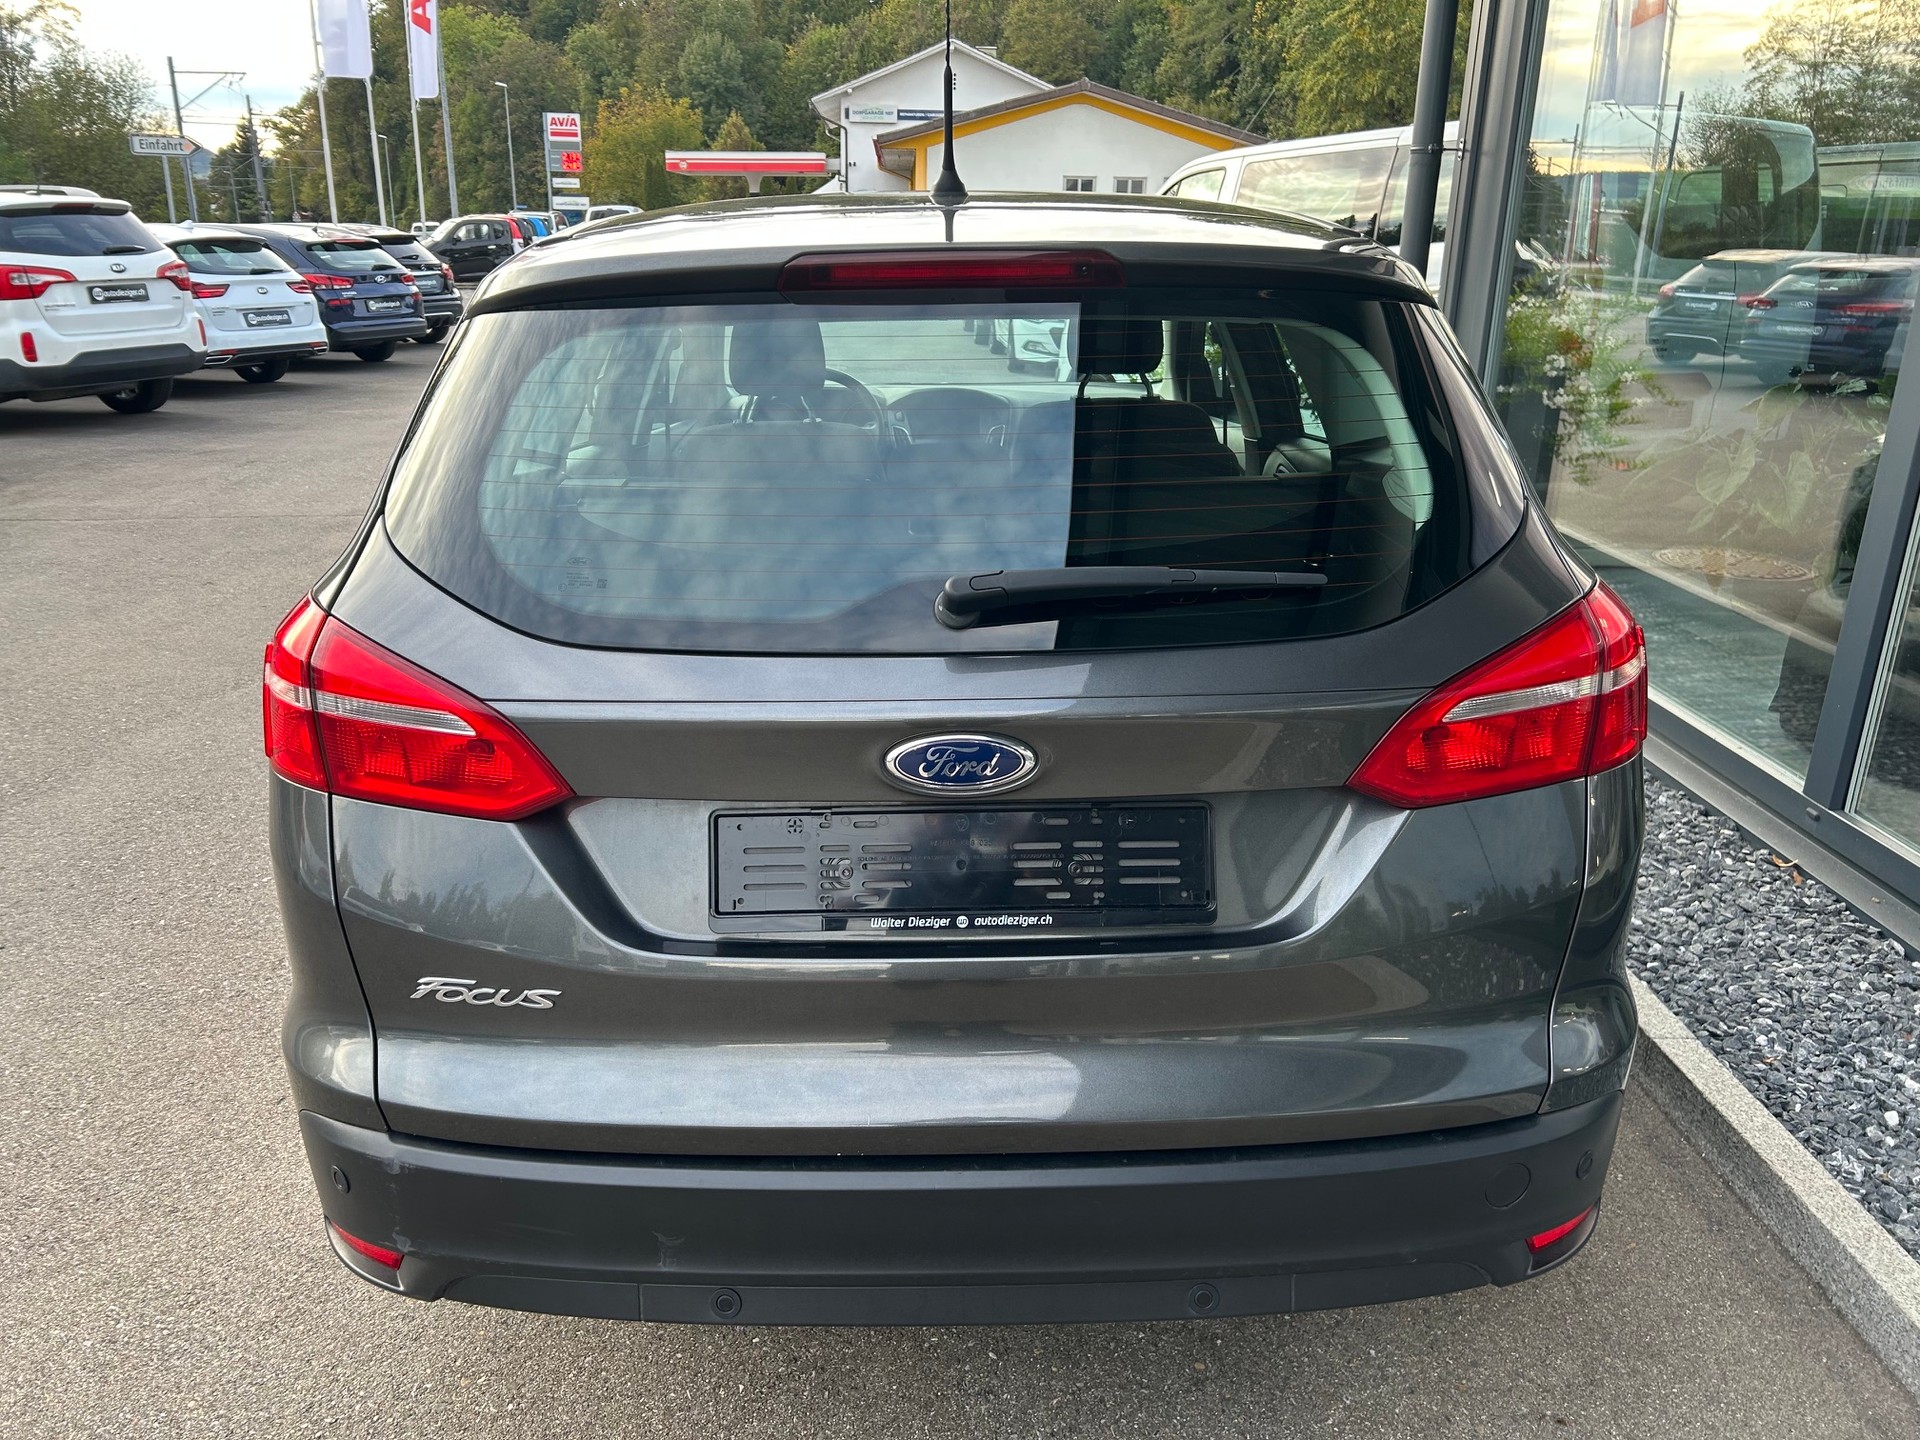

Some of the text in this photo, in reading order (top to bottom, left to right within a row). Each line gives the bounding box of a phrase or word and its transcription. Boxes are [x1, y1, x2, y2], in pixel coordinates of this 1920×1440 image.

[549, 115, 578, 128] AVIA
[138, 138, 184, 151] Einfahrt
[918, 746, 1001, 778] Ford
[870, 916, 906, 928] Walter
[907, 916, 951, 929] Dieziger
[974, 914, 1053, 928] autodieziger.ch
